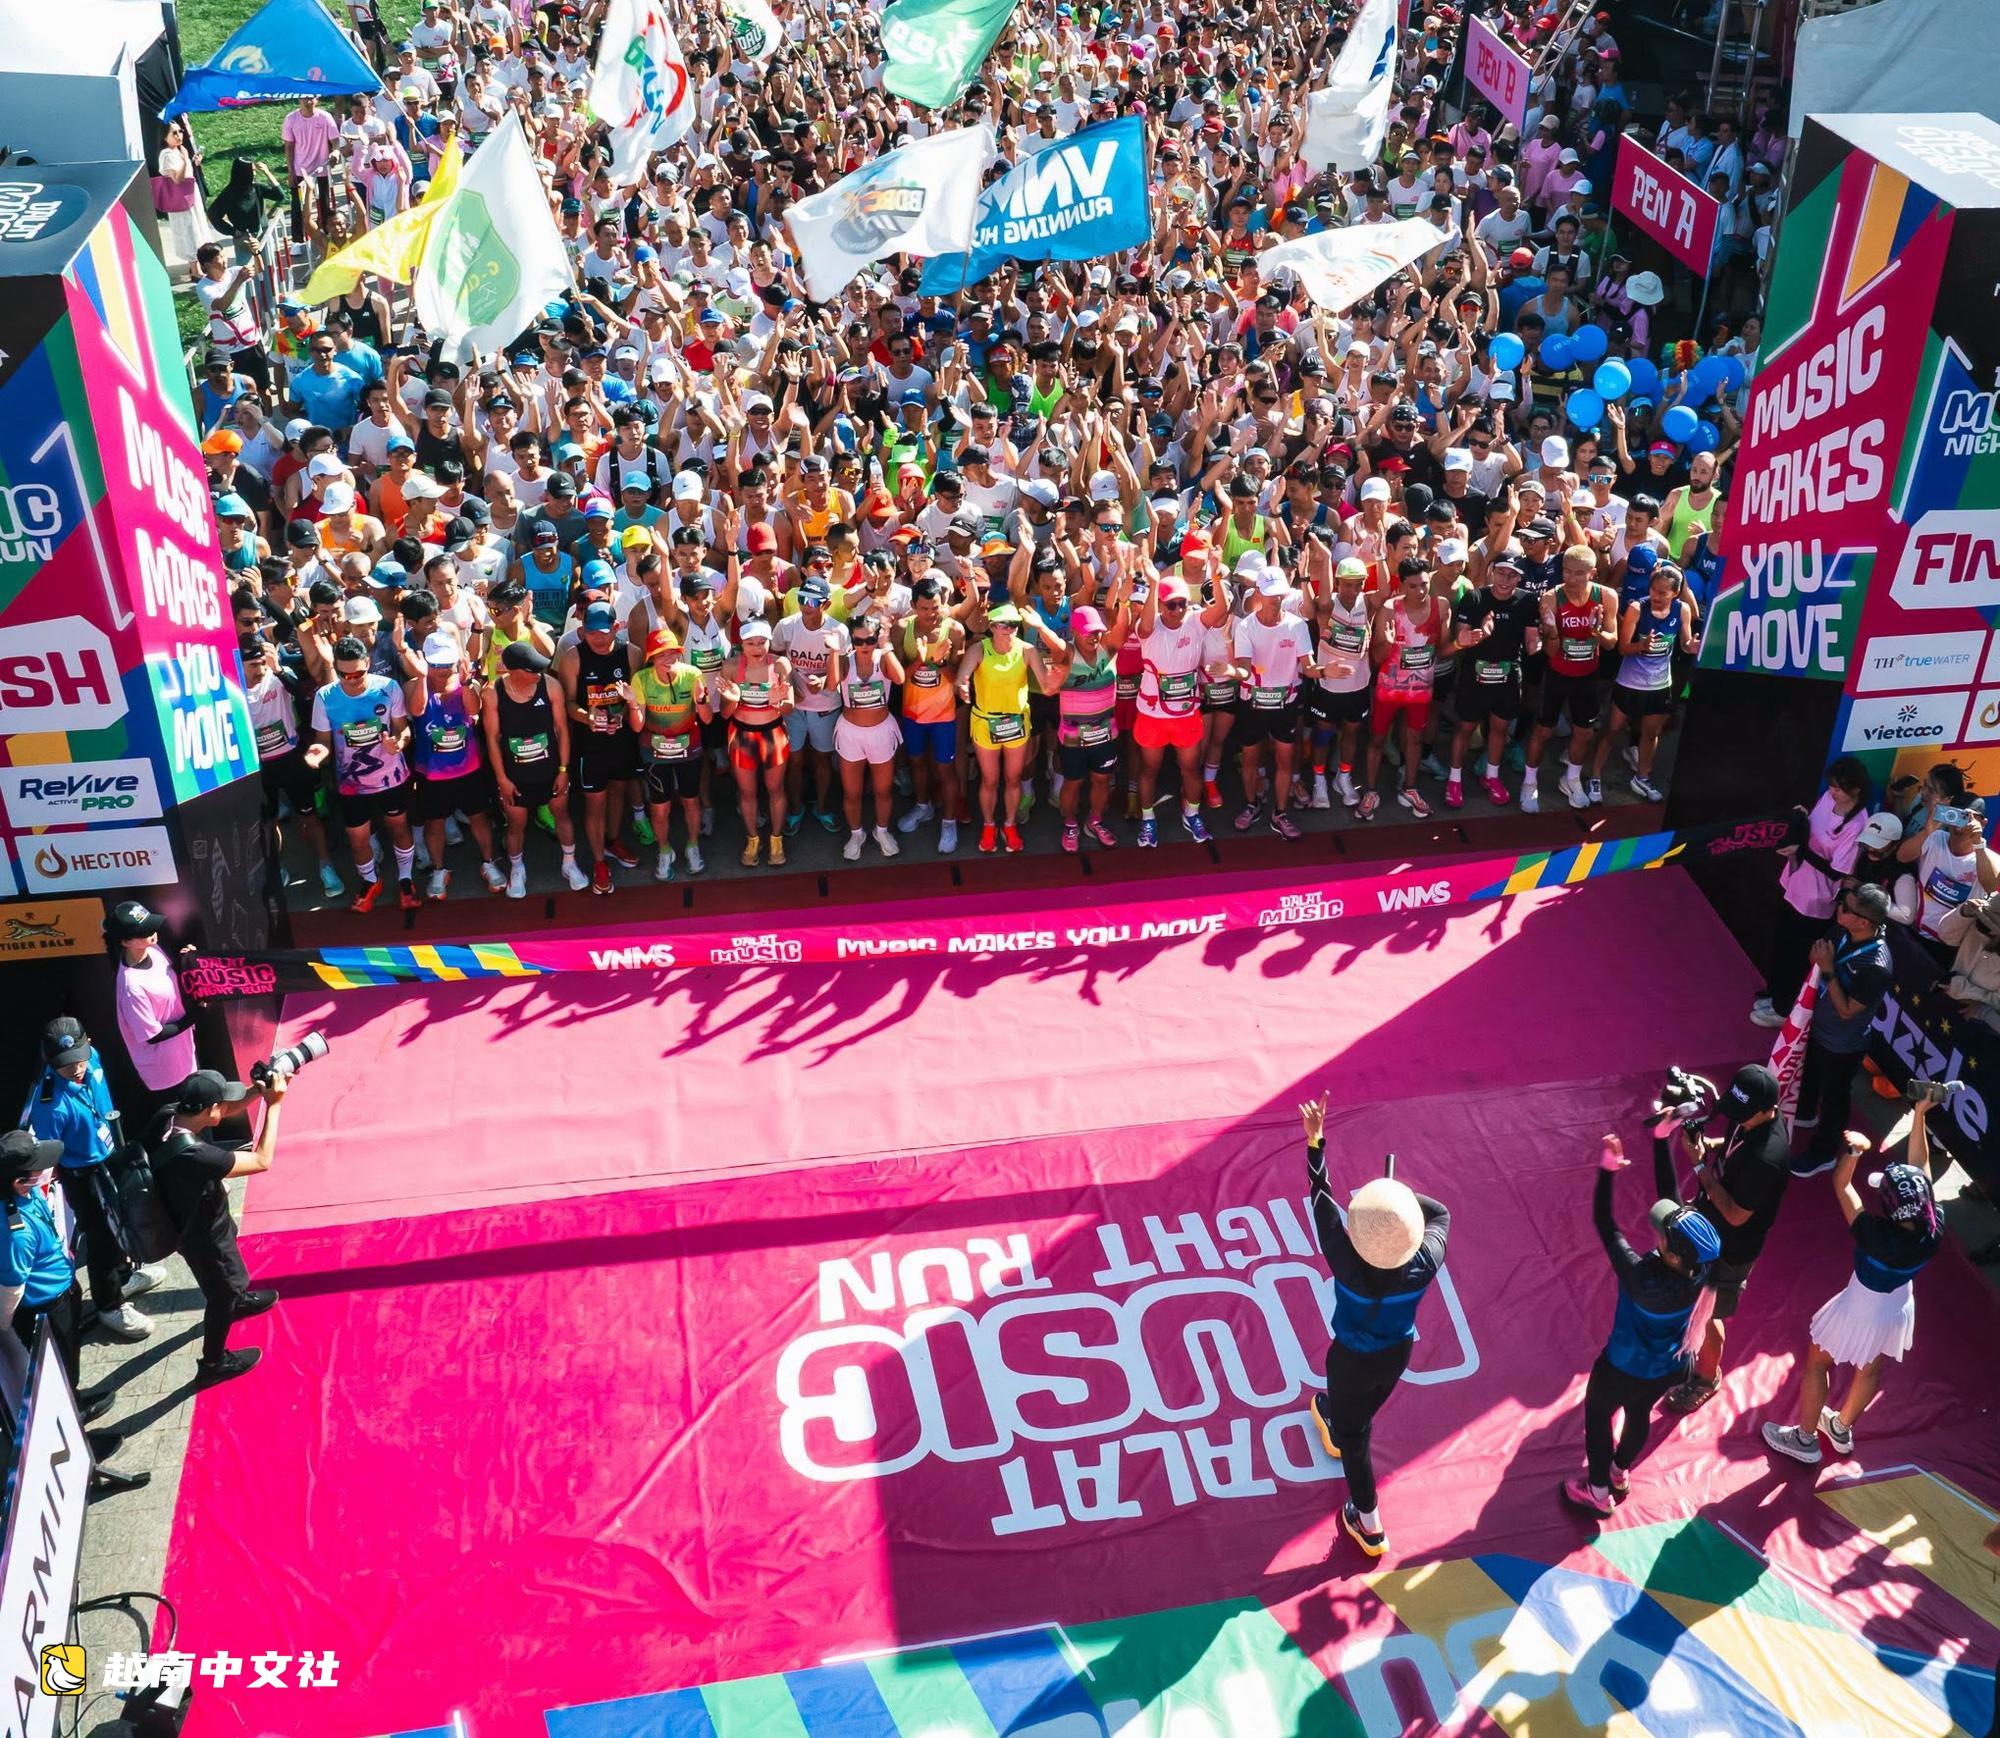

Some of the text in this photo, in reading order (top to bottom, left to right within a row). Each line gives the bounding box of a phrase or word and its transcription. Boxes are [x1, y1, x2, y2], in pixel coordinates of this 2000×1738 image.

[1477, 40, 1516, 104] PEN B
[1631, 166, 1696, 249] PEN A
[1751, 305, 1885, 448] MUSIC
[118, 385, 210, 547] MUSIC
[1741, 419, 1884, 525] MAKES
[135, 528, 221, 630] MAKES
[1742, 538, 1822, 599] YOU
[791, 649, 829, 662] DALAT
[1726, 604, 1844, 672] MOVE
[1874, 657, 1896, 669] TH
[0, 649, 112, 711] SH
[175, 642, 220, 696] YOU
[173, 699, 240, 774] MOVE
[81, 795, 135, 811] PRO
[71, 850, 152, 871] HECTOR
[1258, 899, 1343, 926] MUSIC
[1280, 891, 1322, 908] DALAT
[1377, 881, 1451, 912] VNMS
[589, 944, 676, 970] VNMS
[711, 940, 802, 963] MUSIC
[948, 931, 1056, 952] MAKES
[1066, 925, 1129, 946] YOU
[1140, 913, 1226, 940] MOVE
[182, 964, 276, 994] MUSIC
[819, 1234, 1053, 1323] RUN
[3, 1416, 72, 1738] ARMIN
